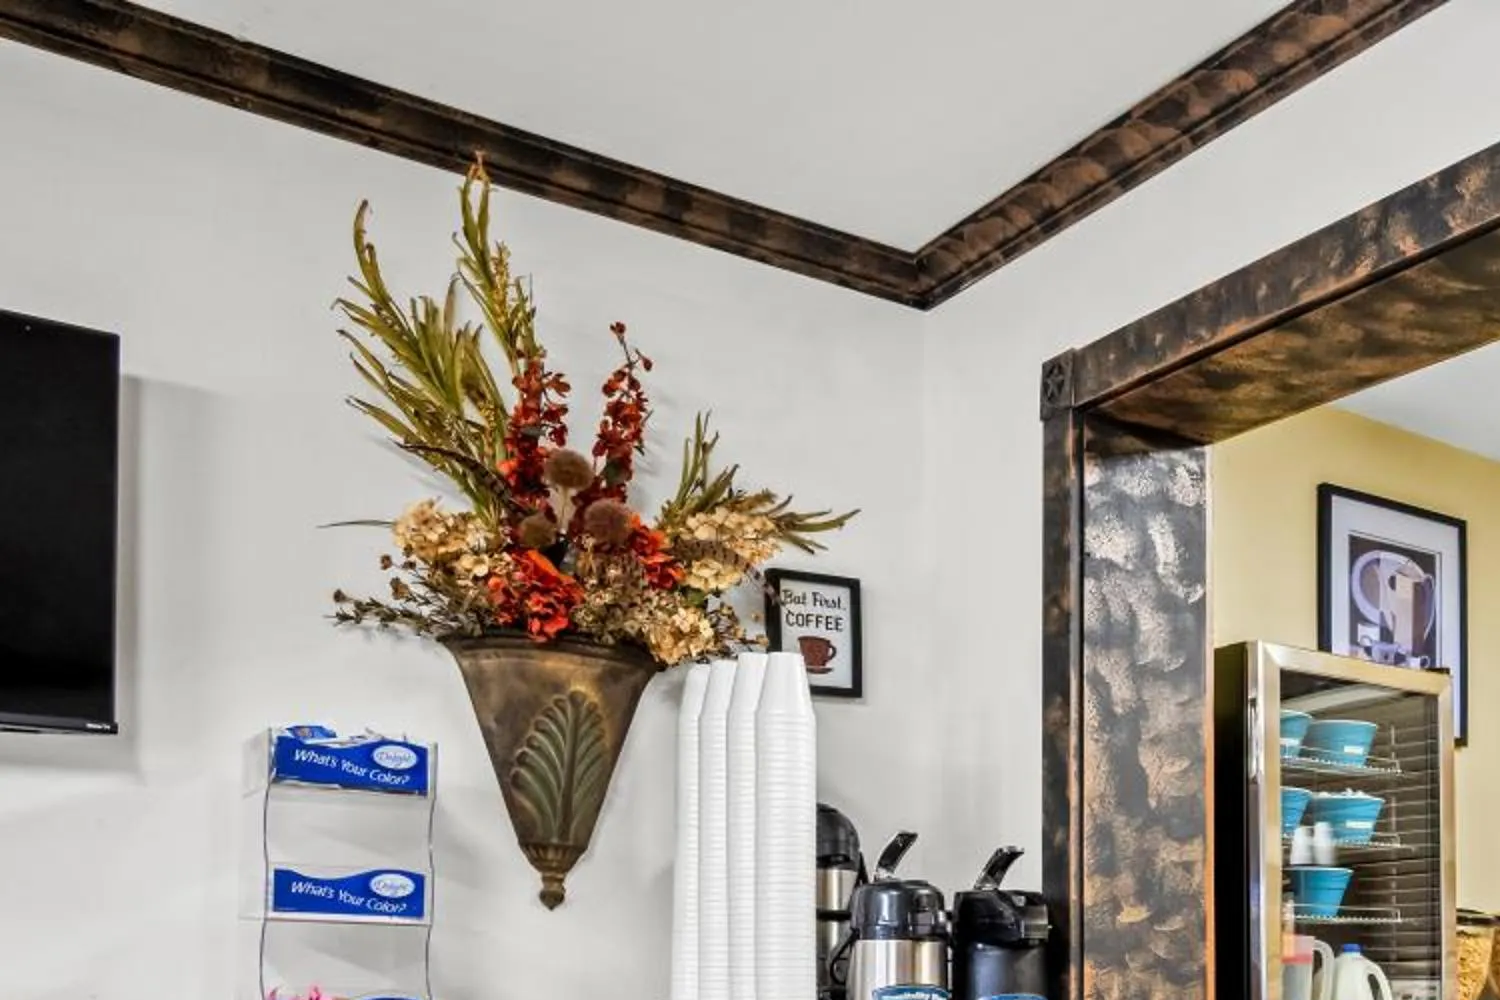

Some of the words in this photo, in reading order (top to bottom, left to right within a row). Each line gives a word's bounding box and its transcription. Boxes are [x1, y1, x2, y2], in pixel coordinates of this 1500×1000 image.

[785, 613, 844, 632] COFFEE
[294, 749, 337, 768] What's
[340, 759, 367, 777] Your
[369, 769, 411, 785] Color?
[291, 881, 335, 899] What's
[339, 889, 365, 906] Your
[366, 897, 407, 913] Color?
